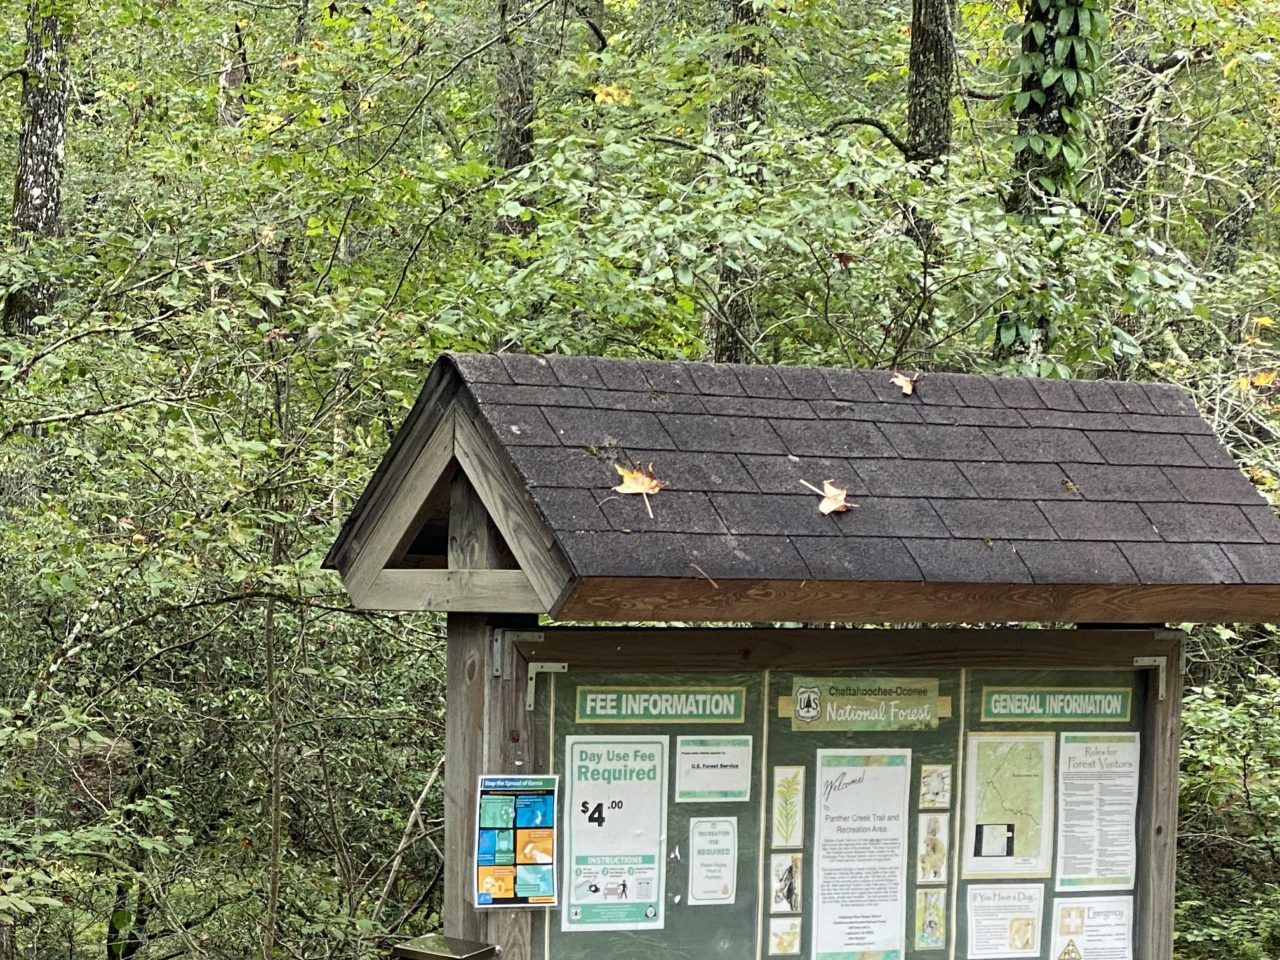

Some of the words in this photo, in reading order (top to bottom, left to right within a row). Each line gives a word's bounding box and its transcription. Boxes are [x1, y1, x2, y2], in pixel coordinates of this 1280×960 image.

[828, 686, 928, 697] Chattahoochee-Oconee
[586, 694, 617, 715] FEE
[621, 694, 735, 715] INFORMATION
[826, 701, 887, 722] National
[889, 700, 932, 721] Forest
[991, 694, 1043, 714] GENERAL
[1046, 694, 1122, 714] INFORMATION
[579, 750, 603, 764] Day
[607, 750, 630, 762] Use
[633, 750, 656, 762] Fee
[1068, 756, 1096, 770] Forest
[1098, 757, 1133, 770] Visitors
[577, 764, 657, 784] Required
[872, 813, 886, 821] Trail
[871, 825, 888, 833] Area
